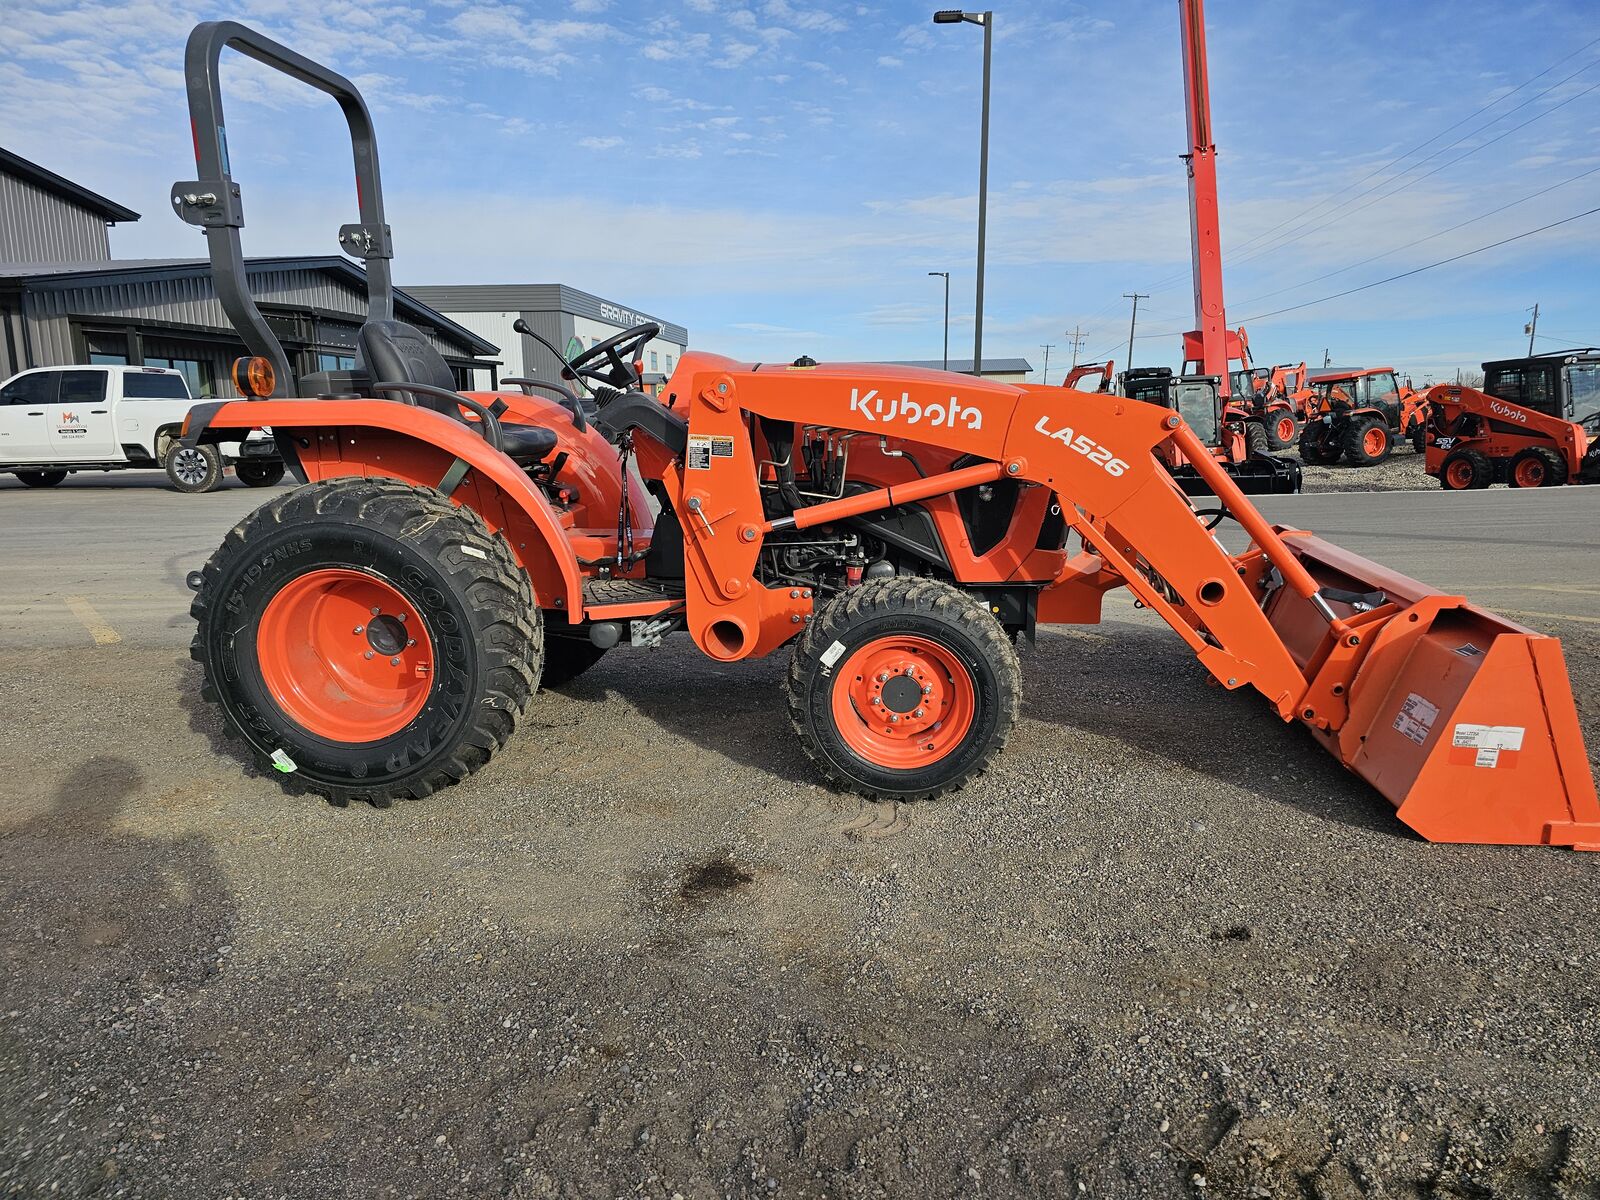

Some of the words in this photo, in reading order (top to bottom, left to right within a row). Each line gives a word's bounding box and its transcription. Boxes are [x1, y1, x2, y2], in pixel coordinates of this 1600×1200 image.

[600, 303, 634, 325] GRAVITY
[849, 388, 982, 430] Kubota
[1490, 401, 1527, 423] Kubota
[1034, 415, 1131, 477] LA526
[1435, 437, 1456, 445] SSV
[386, 564, 470, 773] GOODYEAR
